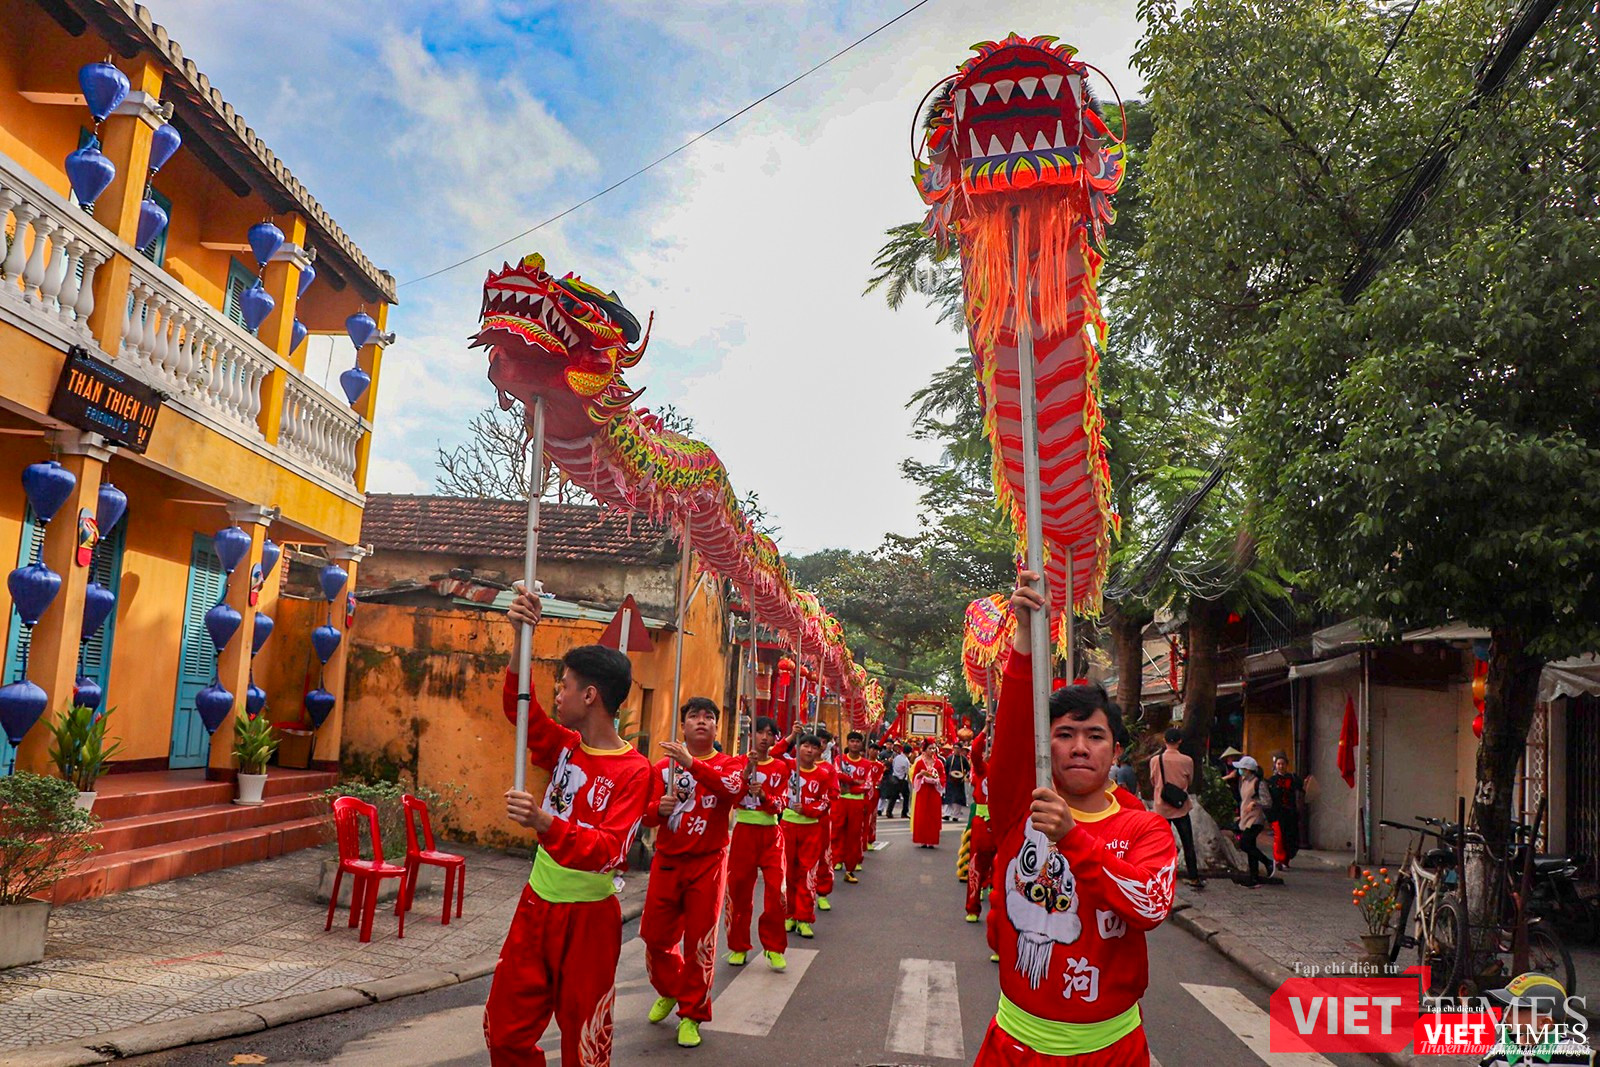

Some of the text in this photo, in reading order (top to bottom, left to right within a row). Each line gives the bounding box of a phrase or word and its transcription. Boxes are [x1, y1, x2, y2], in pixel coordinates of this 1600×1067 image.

[68, 369, 104, 403] THÂN
[105, 387, 141, 421] THIỆN
[85, 406, 121, 431] FRIENDLY
